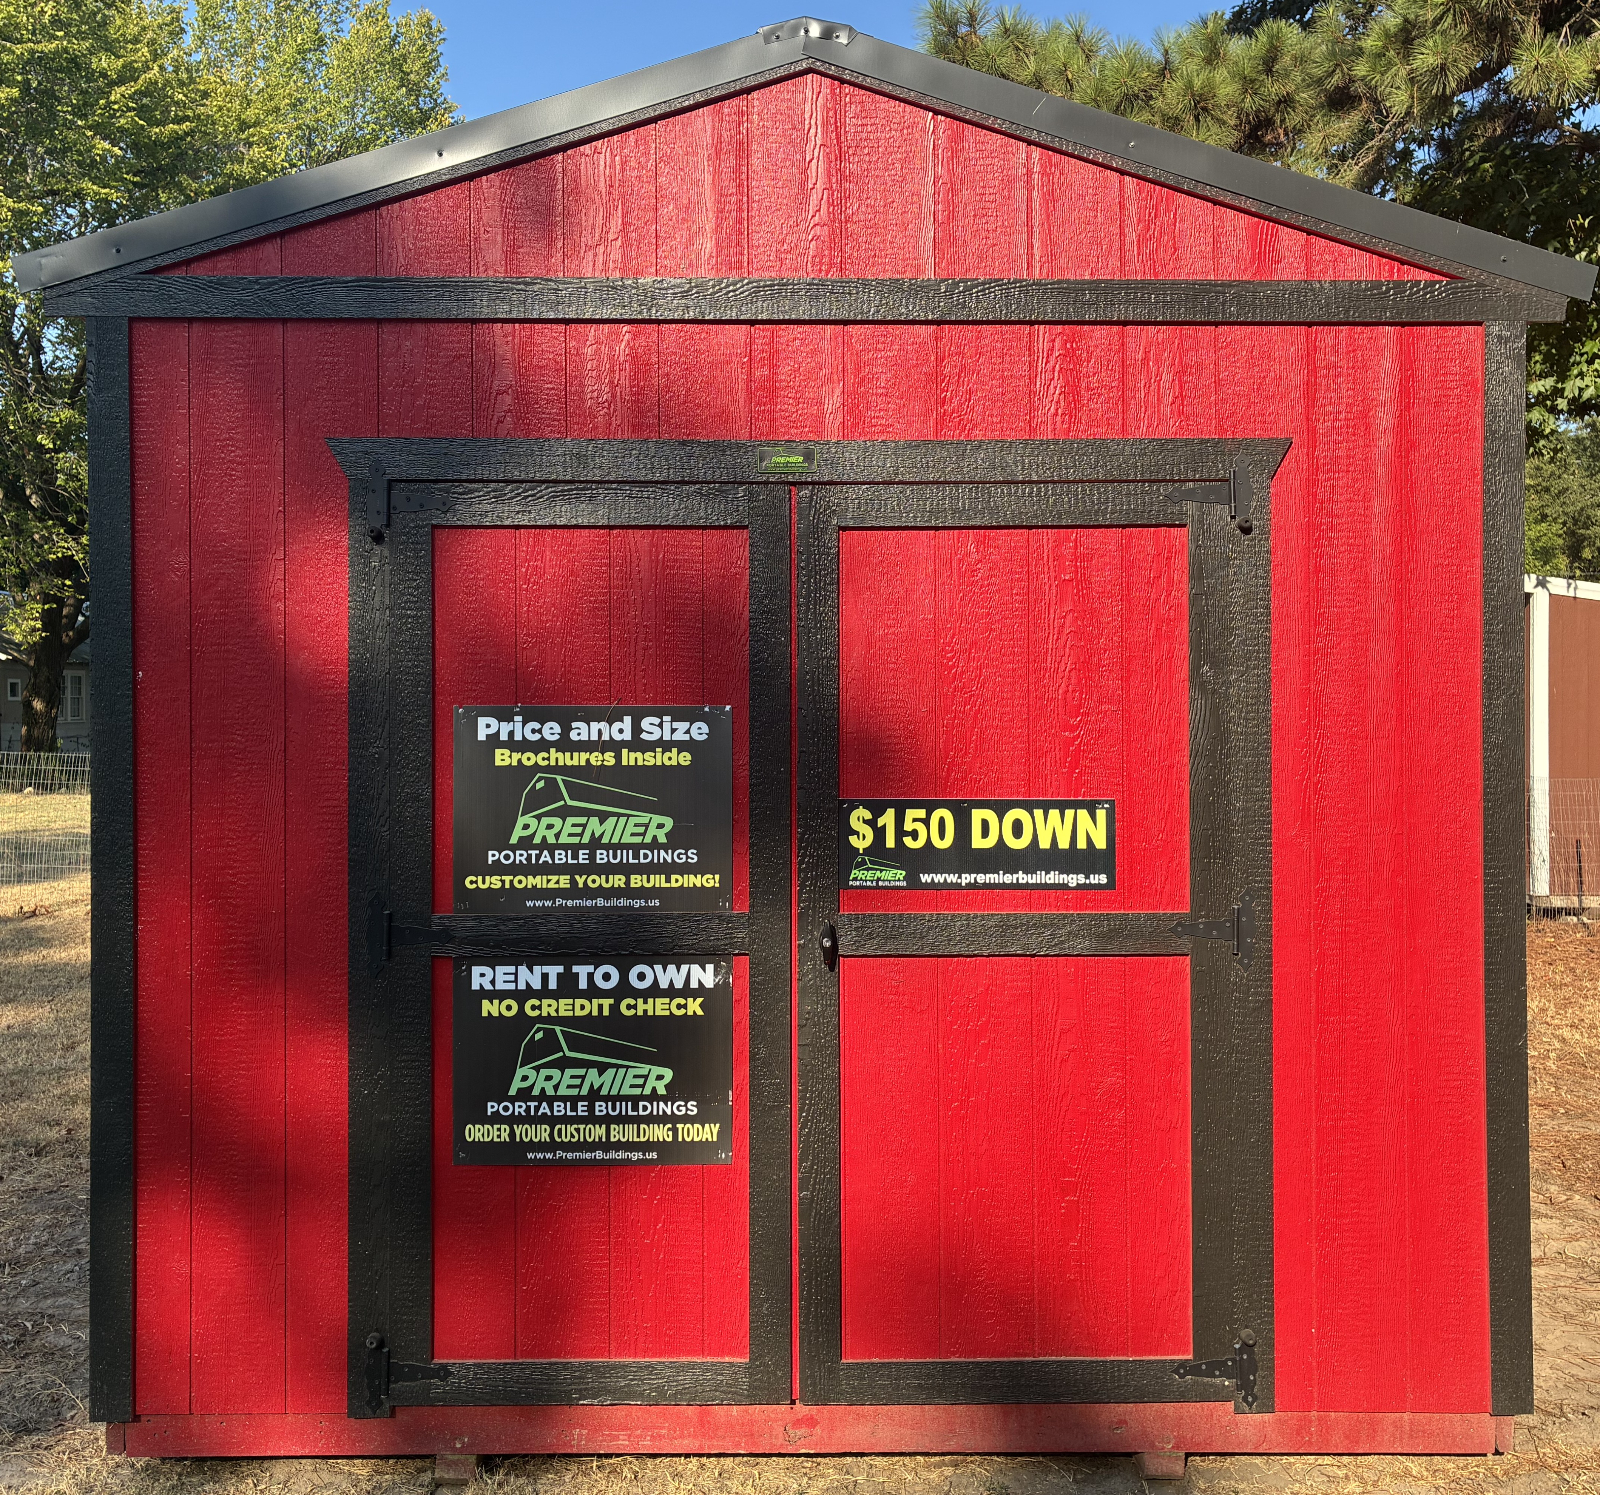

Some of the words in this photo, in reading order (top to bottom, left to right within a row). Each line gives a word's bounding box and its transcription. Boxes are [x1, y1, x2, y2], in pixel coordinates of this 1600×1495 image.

[478, 716, 561, 741] Price
[570, 716, 631, 741] and
[640, 715, 709, 741] Size
[494, 749, 615, 766] Brochures
[622, 748, 692, 766] Inside
[509, 817, 673, 844] PREMIER
[848, 806, 954, 853] $150
[972, 808, 1107, 849] DOWN
[488, 850, 589, 864] PORTABLE
[596, 849, 698, 863] BUILDINGS
[465, 875, 570, 889] CUSTOMIZE
[574, 875, 626, 888] YOUR
[630, 874, 720, 888] BUILDING!
[849, 870, 906, 880] PREMIER
[920, 870, 1107, 887] www.premierbuildings.us
[526, 898, 660, 909] www.PremierBuildings.us
[471, 965, 564, 990] RENT
[572, 965, 620, 989] TO
[628, 964, 714, 989] OWN
[481, 999, 518, 1017] NO
[524, 998, 614, 1017] CREDIT
[620, 997, 704, 1016] CHECK
[508, 1068, 673, 1096] PREMIER
[487, 1102, 588, 1116] PORTABLE
[595, 1101, 697, 1115] BUILDINGS
[465, 1124, 510, 1142] ORDER
[513, 1124, 550, 1142] YOUR
[554, 1124, 606, 1142] CUSTOM
[610, 1124, 673, 1142] BUILDING
[677, 1123, 720, 1141] TODAY
[526, 1151, 657, 1160] www.PremierBuildings.us
